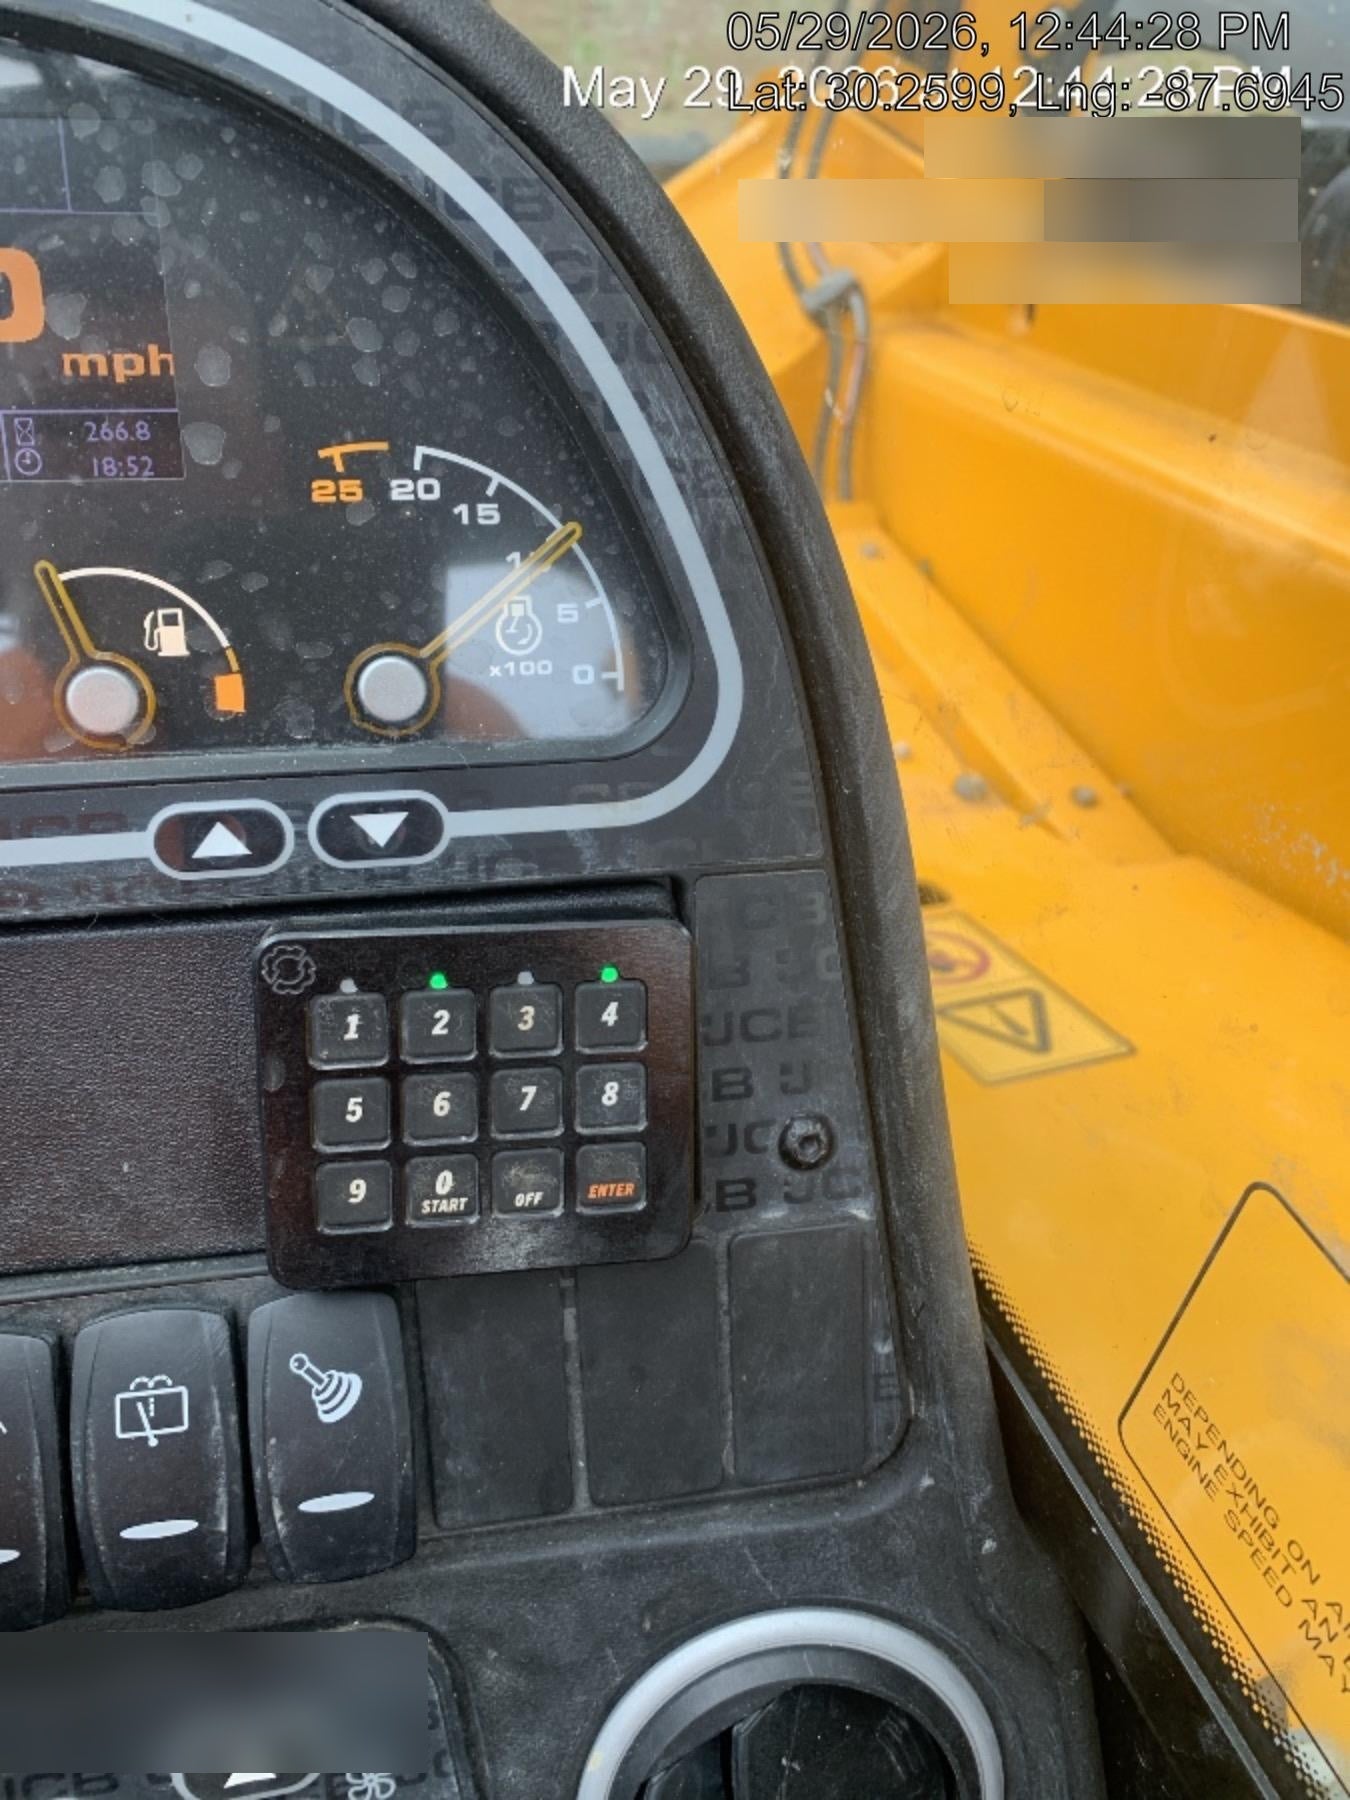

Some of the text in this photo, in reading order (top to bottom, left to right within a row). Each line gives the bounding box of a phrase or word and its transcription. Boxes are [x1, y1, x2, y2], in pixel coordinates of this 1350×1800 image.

[61, 343, 175, 384] mph
[84, 420, 151, 442] 266.8
[92, 456, 155, 478] 18:52
[311, 479, 363, 503] 25
[390, 478, 441, 501] 20
[452, 503, 501, 525] 15
[557, 603, 579, 624] 5
[489, 660, 553, 678] x100
[573, 665, 595, 685] 0
[343, 1013, 361, 1041] 1
[431, 1009, 450, 1036] 2
[517, 1005, 535, 1032] 3
[601, 1001, 619, 1027] 4
[433, 1091, 451, 1117] 6
[518, 1085, 537, 1111] 7
[601, 1081, 619, 1107] 8
[345, 1097, 363, 1123] 5
[348, 1179, 367, 1204] 9
[435, 1170, 454, 1196] 0
[587, 1182, 636, 1199] ENTER
[421, 1197, 468, 1214] START
[514, 1191, 544, 1208] OFF
[1162, 1388, 1209, 1451] MAY
[1213, 1463, 1297, 1575] EXHIBIT
[1171, 1372, 1280, 1530] DEPENDING
[1286, 1538, 1321, 1586] ON
[1153, 1403, 1218, 1503] ENGINE
[1224, 1508, 1294, 1609] SPEED
